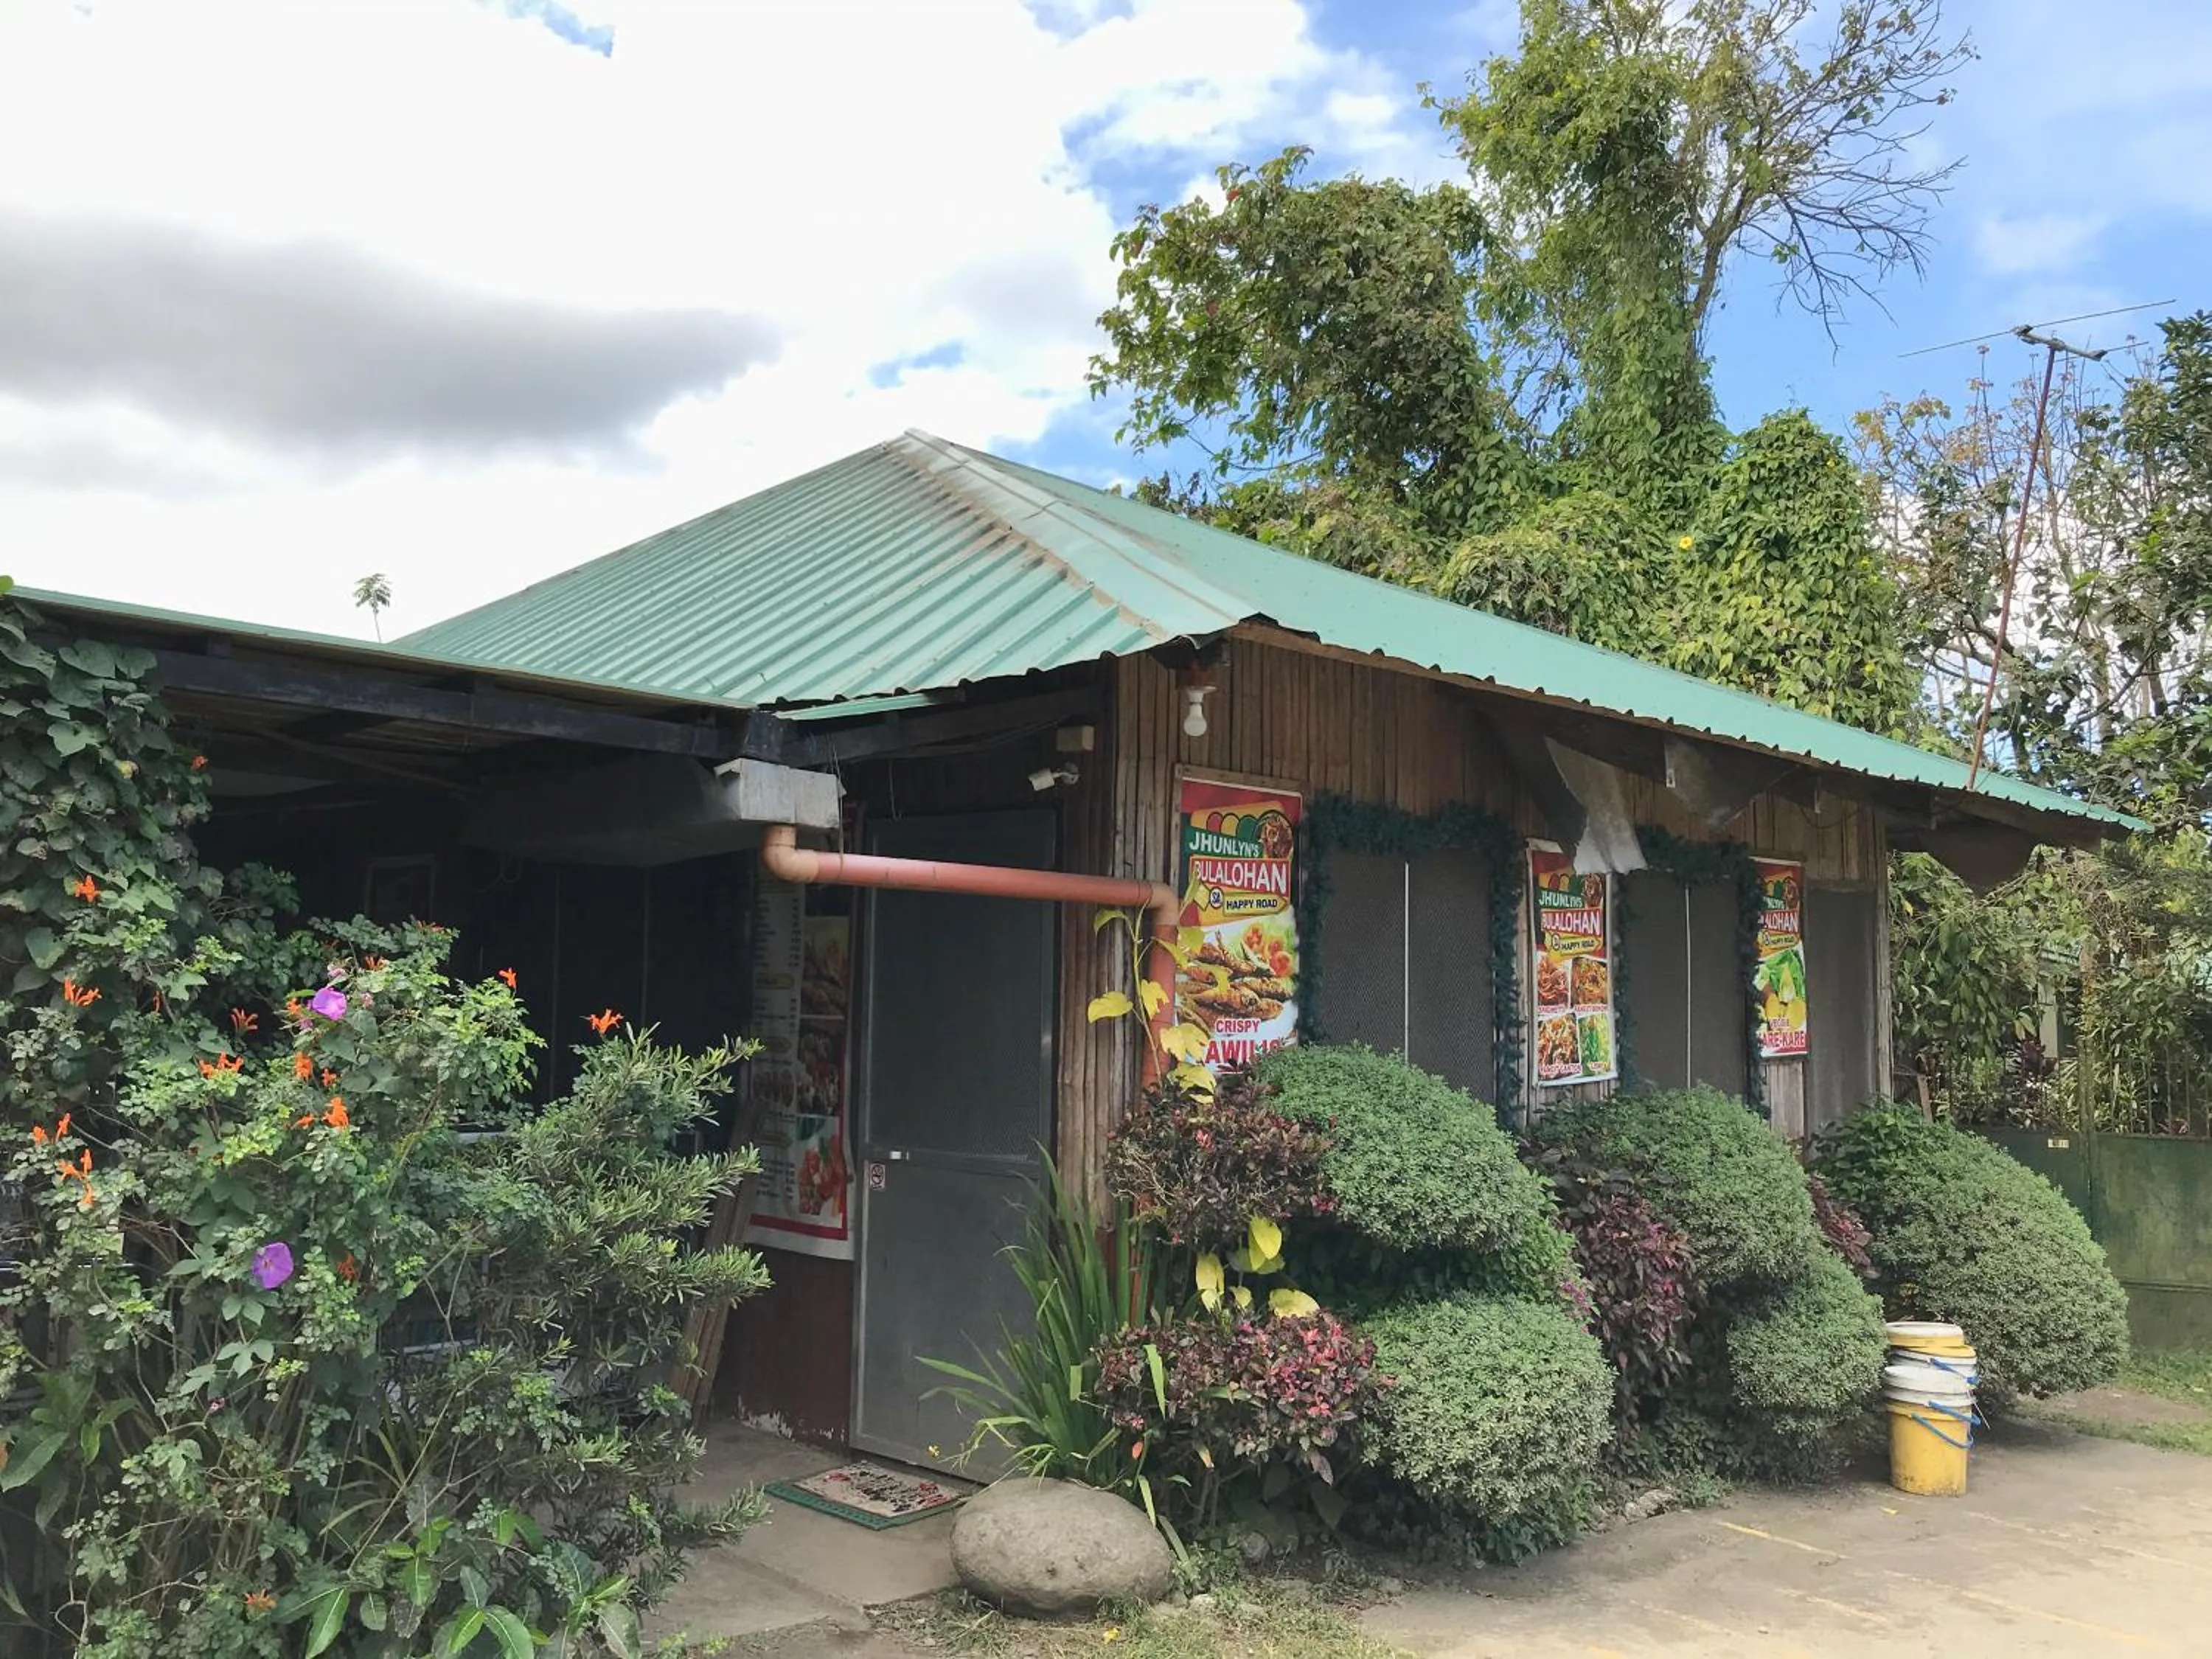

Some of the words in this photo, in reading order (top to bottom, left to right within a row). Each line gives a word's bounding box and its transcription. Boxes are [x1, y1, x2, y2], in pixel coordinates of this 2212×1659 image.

[1189, 831, 1259, 858] JHUNLYN'S
[1226, 900, 1254, 911] HAPPY
[1256, 899, 1278, 909] ROAD
[1216, 1019, 1260, 1033] CRISPY
